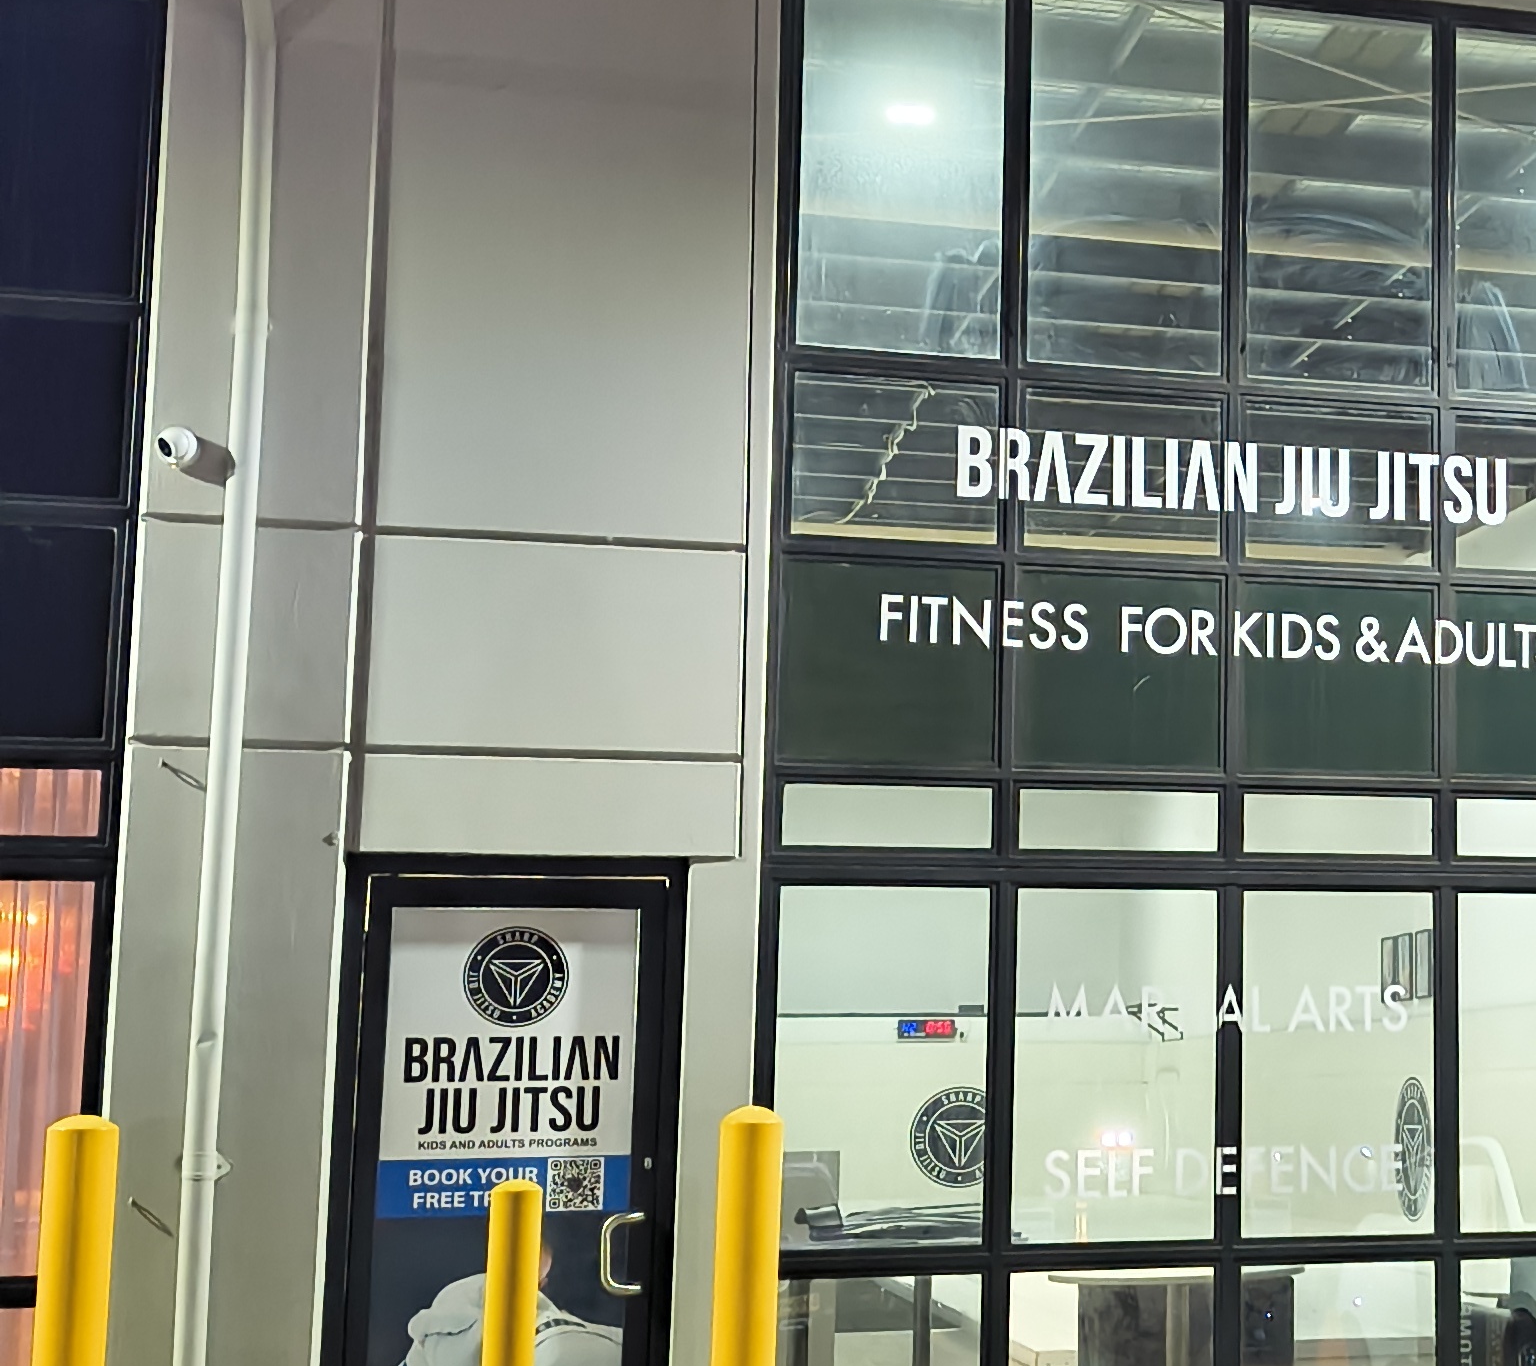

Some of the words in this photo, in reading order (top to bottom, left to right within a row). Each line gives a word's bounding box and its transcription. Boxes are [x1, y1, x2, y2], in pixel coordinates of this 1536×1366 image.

[956, 424, 1258, 513] BRAZILIAN
[1274, 445, 1351, 518] JIU
[1369, 450, 1507, 526] JITSU
[878, 592, 1090, 652] FITNESS
[1119, 605, 1218, 658] FOR
[1232, 610, 1341, 661] KIDS
[1286, 984, 1409, 1033] ARTS
[403, 1035, 621, 1084] BRAZILIAN
[417, 1086, 478, 1135] JIU
[489, 1085, 601, 1134] JITSU
[417, 1140, 447, 1151] KIDS
[449, 1140, 476, 1150] AND
[478, 1138, 526, 1149] ADULTS
[528, 1137, 598, 1148] PROGRAMS
[408, 1168, 473, 1186] BOOK
[1045, 1148, 1155, 1199] SELF
[412, 1191, 466, 1209] FREE
